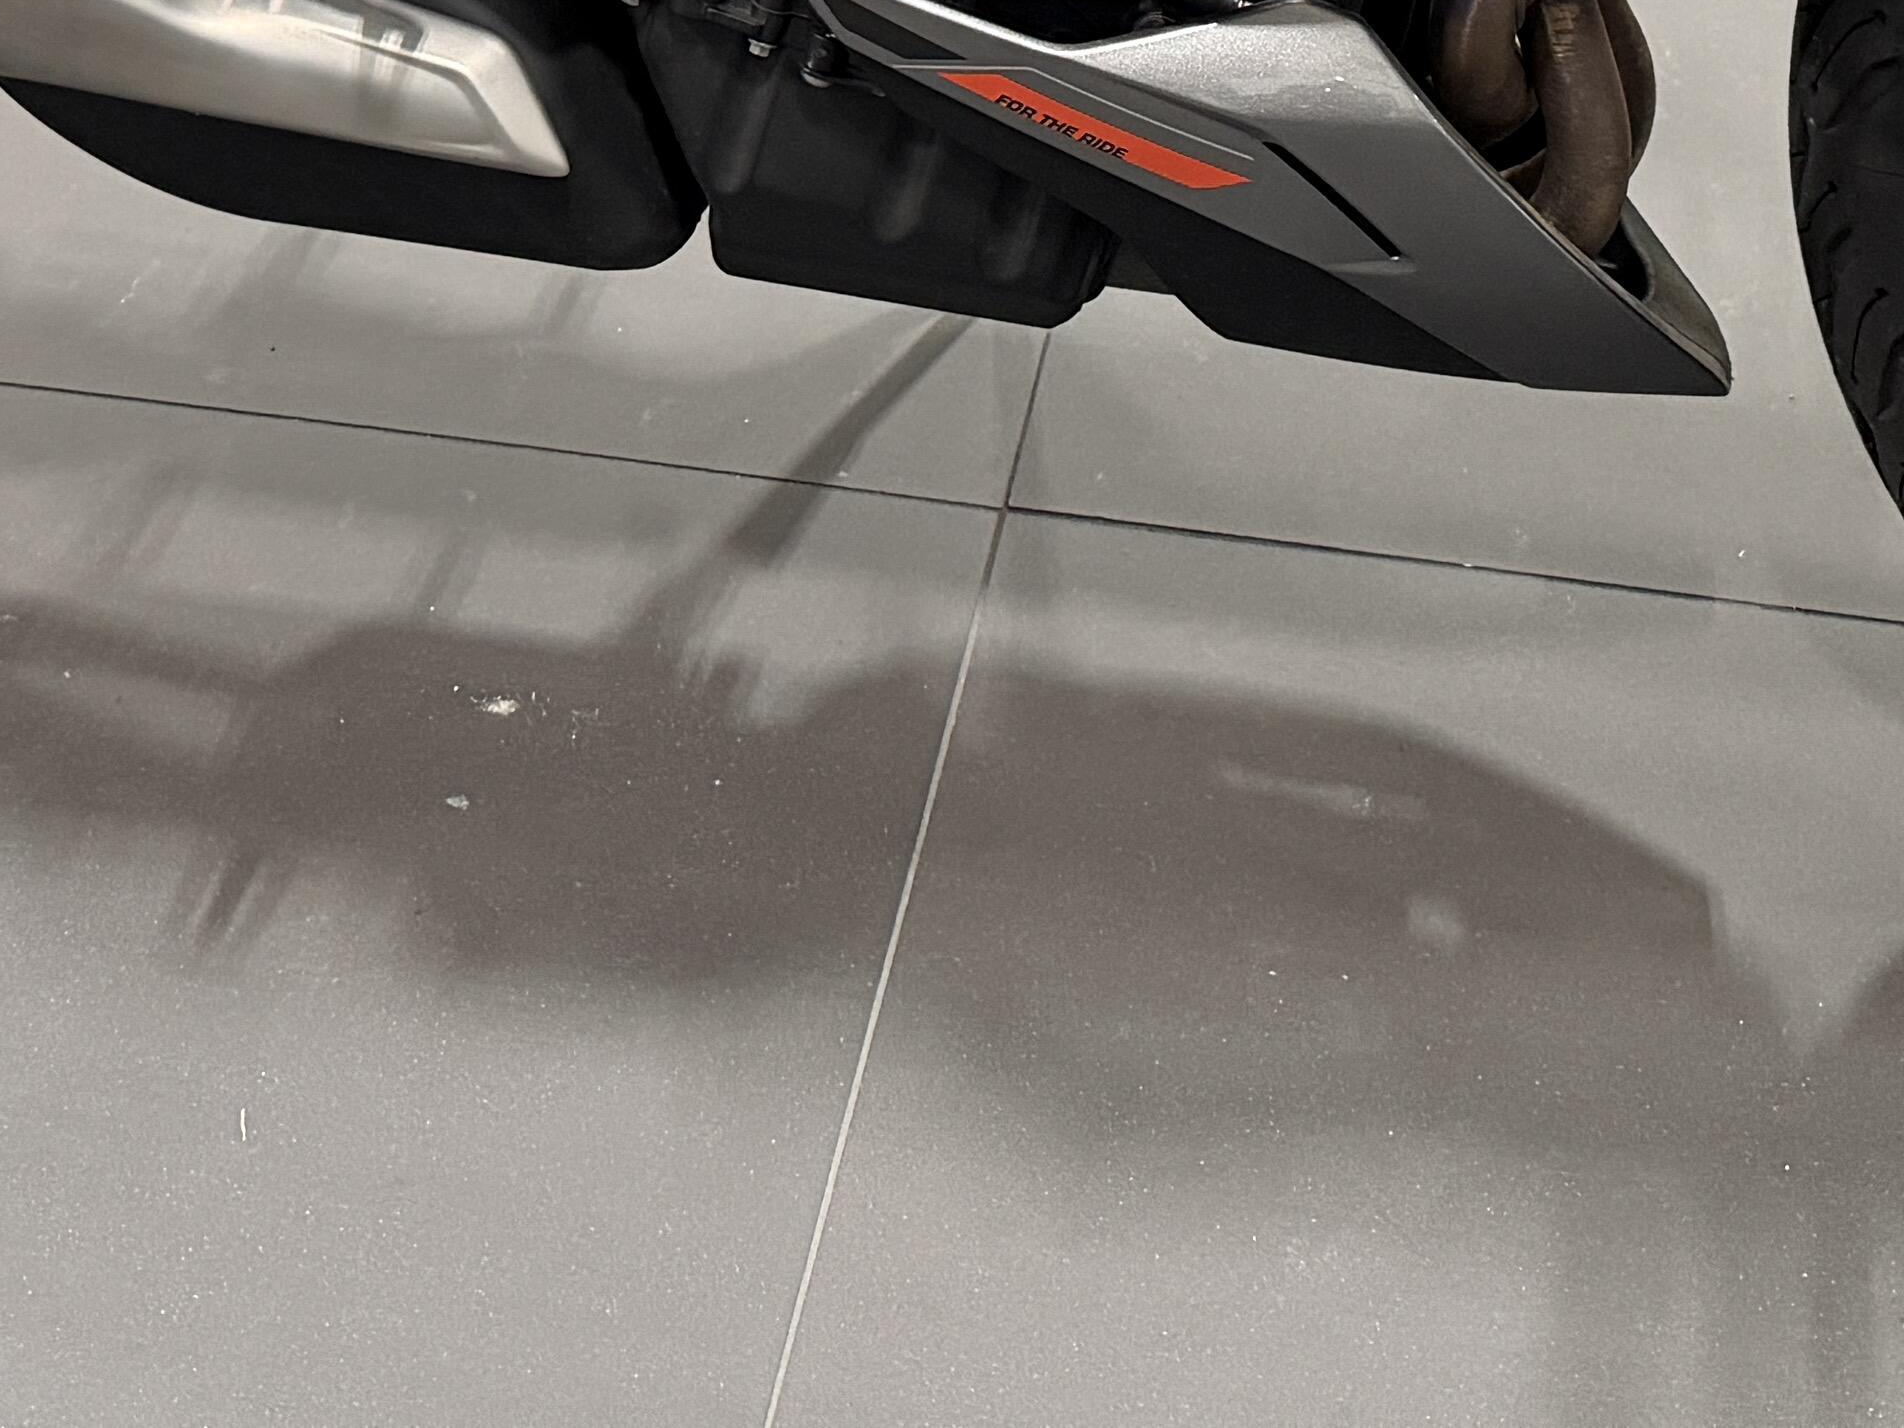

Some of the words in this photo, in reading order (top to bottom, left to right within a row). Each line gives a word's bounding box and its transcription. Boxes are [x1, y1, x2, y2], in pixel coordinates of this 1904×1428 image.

[993, 93, 1038, 121] FOR
[1038, 113, 1080, 138] THE
[1078, 131, 1129, 160] RIDE
